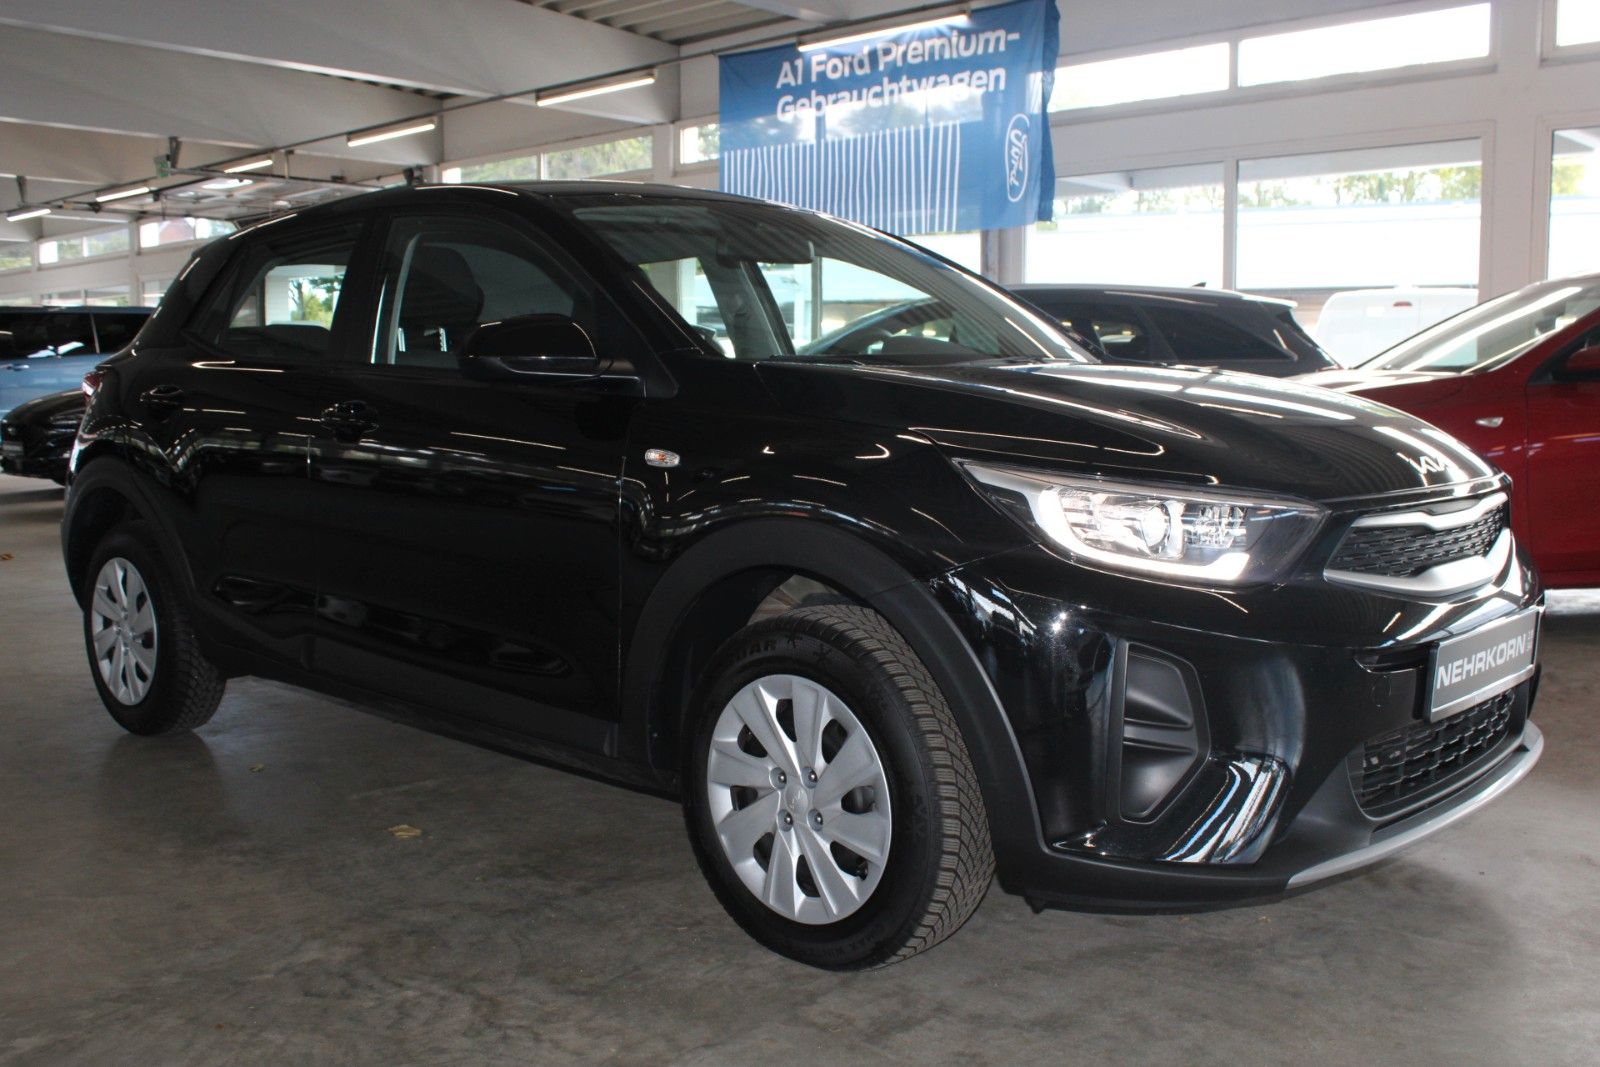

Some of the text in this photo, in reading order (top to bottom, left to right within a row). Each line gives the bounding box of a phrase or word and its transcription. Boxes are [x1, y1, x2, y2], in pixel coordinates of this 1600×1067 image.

[811, 45, 871, 82] Ford
[876, 28, 1021, 72] Premium-
[776, 66, 1006, 123] Gebrauchtwagen
[1436, 633, 1526, 691] NEHRKORN
